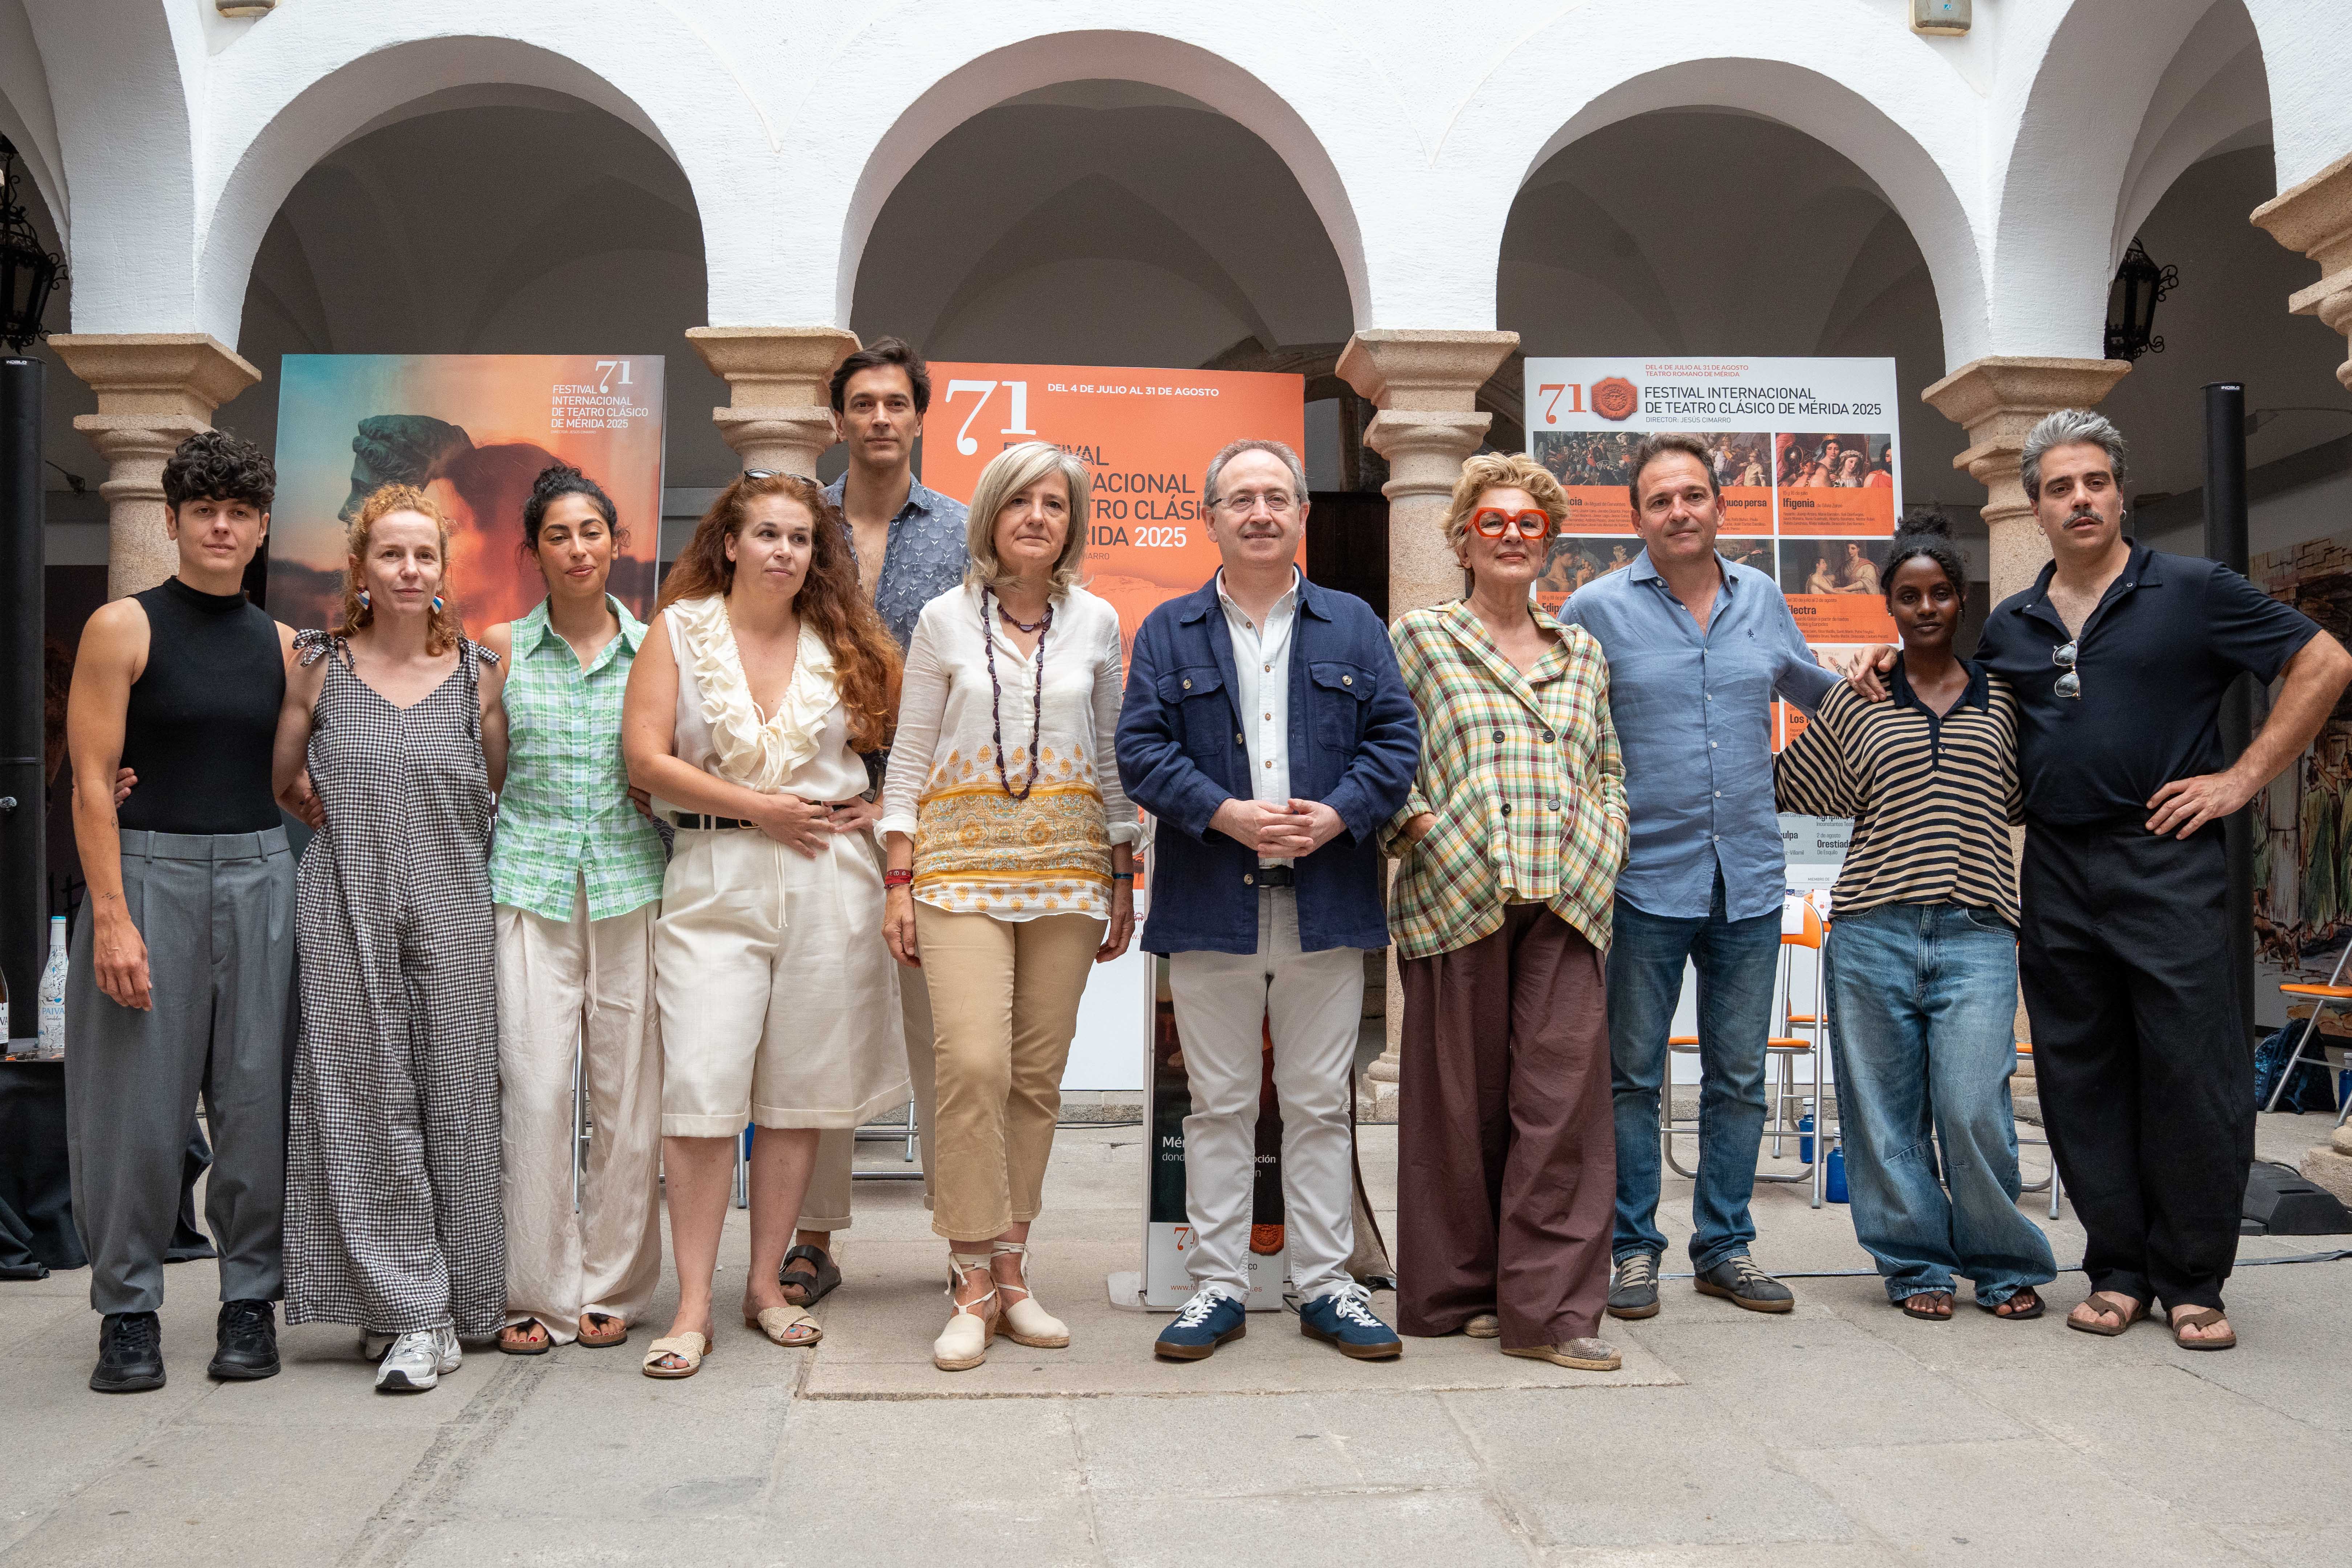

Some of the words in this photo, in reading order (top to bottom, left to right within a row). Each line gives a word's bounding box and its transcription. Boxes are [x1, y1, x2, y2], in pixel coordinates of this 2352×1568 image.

[595, 361, 633, 394] 71
[553, 385, 597, 394] FESTIVAL
[1048, 383, 1068, 392] DEL
[1071, 384, 1077, 392] 4
[1080, 384, 1094, 393] DE
[1096, 385, 1126, 394] JULIO
[1129, 386, 1143, 395] AL
[1146, 387, 1155, 395] 31
[1158, 387, 1172, 395] DE
[1175, 388, 1219, 396] AGOSTO
[1645, 387, 1704, 398] FESTIVAL
[1708, 387, 1815, 399] INTERNACIONAL
[552, 396, 633, 405] INTERNACIONAL
[1539, 384, 1587, 424] 71
[552, 408, 564, 416] DE
[567, 408, 604, 416] TEATRO
[607, 405, 648, 417] CLÁSICO
[1646, 402, 1659, 413] DE
[1662, 402, 1715, 413] TEATRO
[1719, 399, 1775, 414] CLÁSICO
[1779, 403, 1795, 414] DE
[1799, 400, 1849, 415] MÉRIDA
[1852, 404, 1881, 415] 2025
[551, 419, 564, 428] DE
[566, 416, 604, 428] MÉRIDA
[607, 419, 628, 428] 2025
[945, 379, 1036, 456] 71
[1089, 472, 1195, 493] ACIONAL
[1569, 497, 1582, 506] cia
[1745, 500, 1767, 509] persa
[1783, 498, 1815, 510] Ifigenia
[1088, 526, 1129, 546] IDA
[1134, 526, 1186, 547] 2025
[1790, 714, 1804, 723] Los
